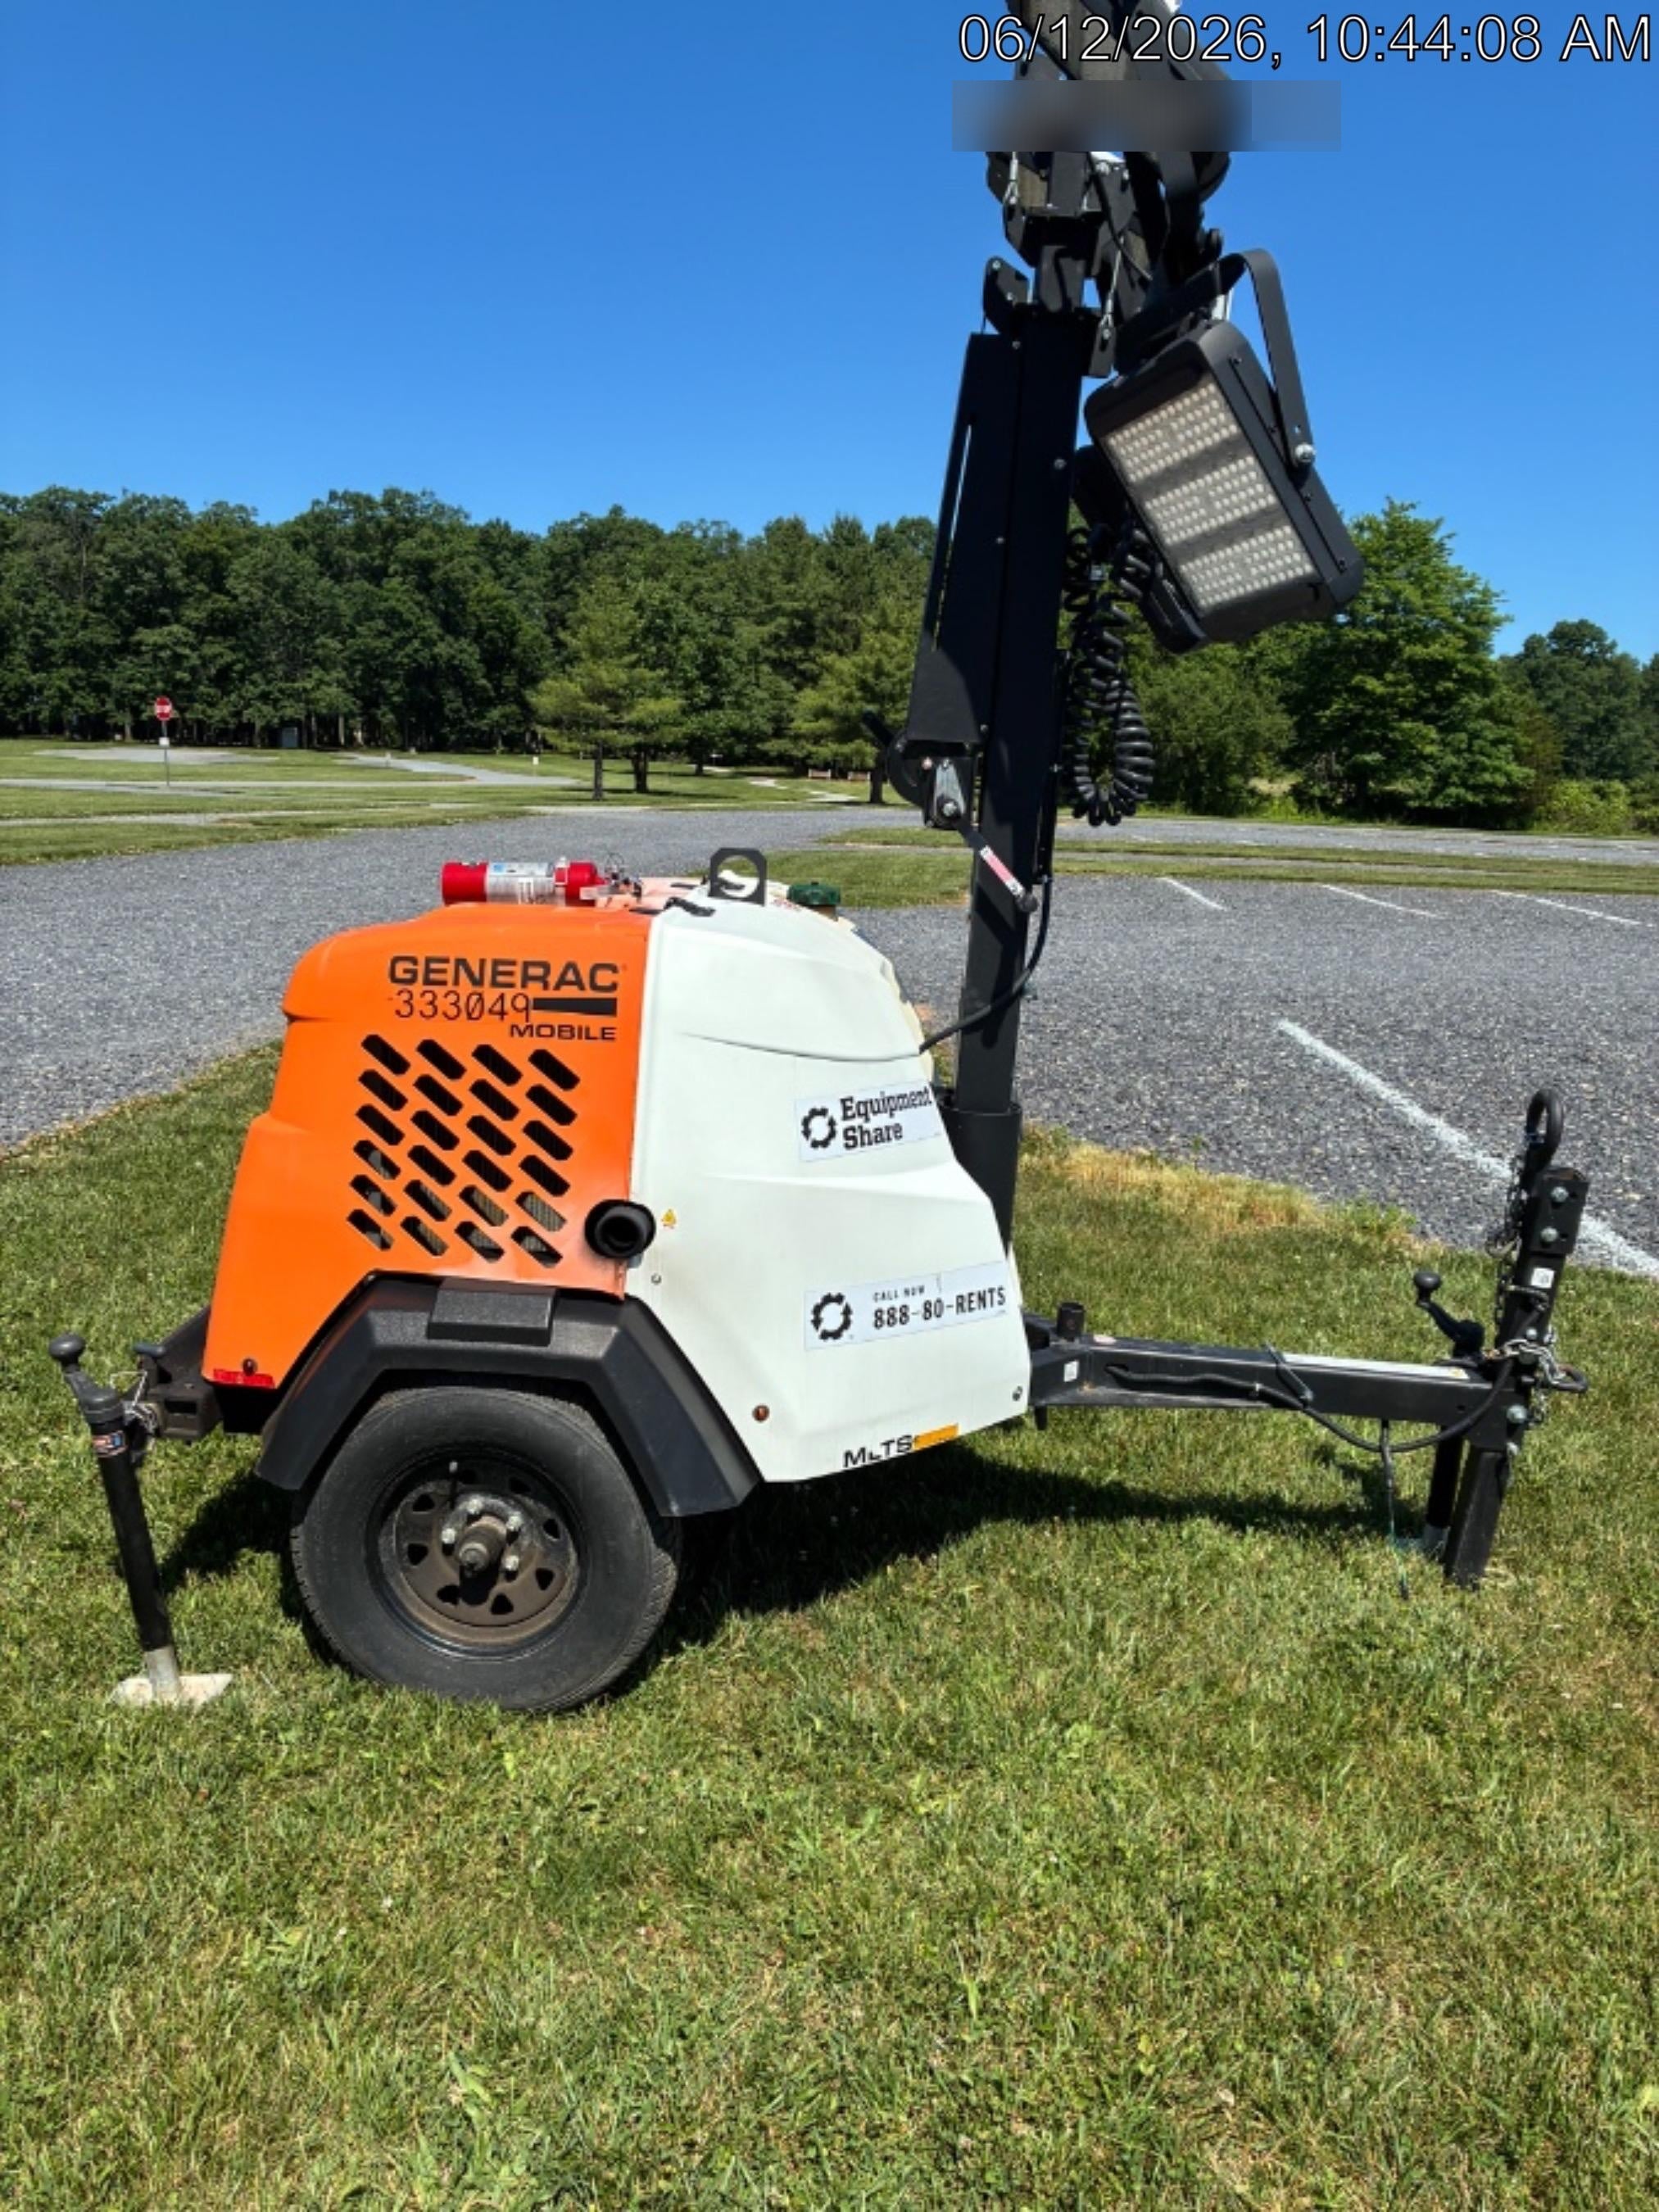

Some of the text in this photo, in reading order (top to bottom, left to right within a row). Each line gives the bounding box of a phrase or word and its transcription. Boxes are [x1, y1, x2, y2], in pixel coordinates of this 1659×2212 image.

[388, 955, 619, 993] GENERAC
[394, 988, 531, 1023] 333049
[510, 1024, 618, 1040] MOBILE
[840, 1086, 932, 1123] Equipment
[842, 1122, 904, 1150] Share
[873, 1285, 1007, 1330] 888-80-RENTS
